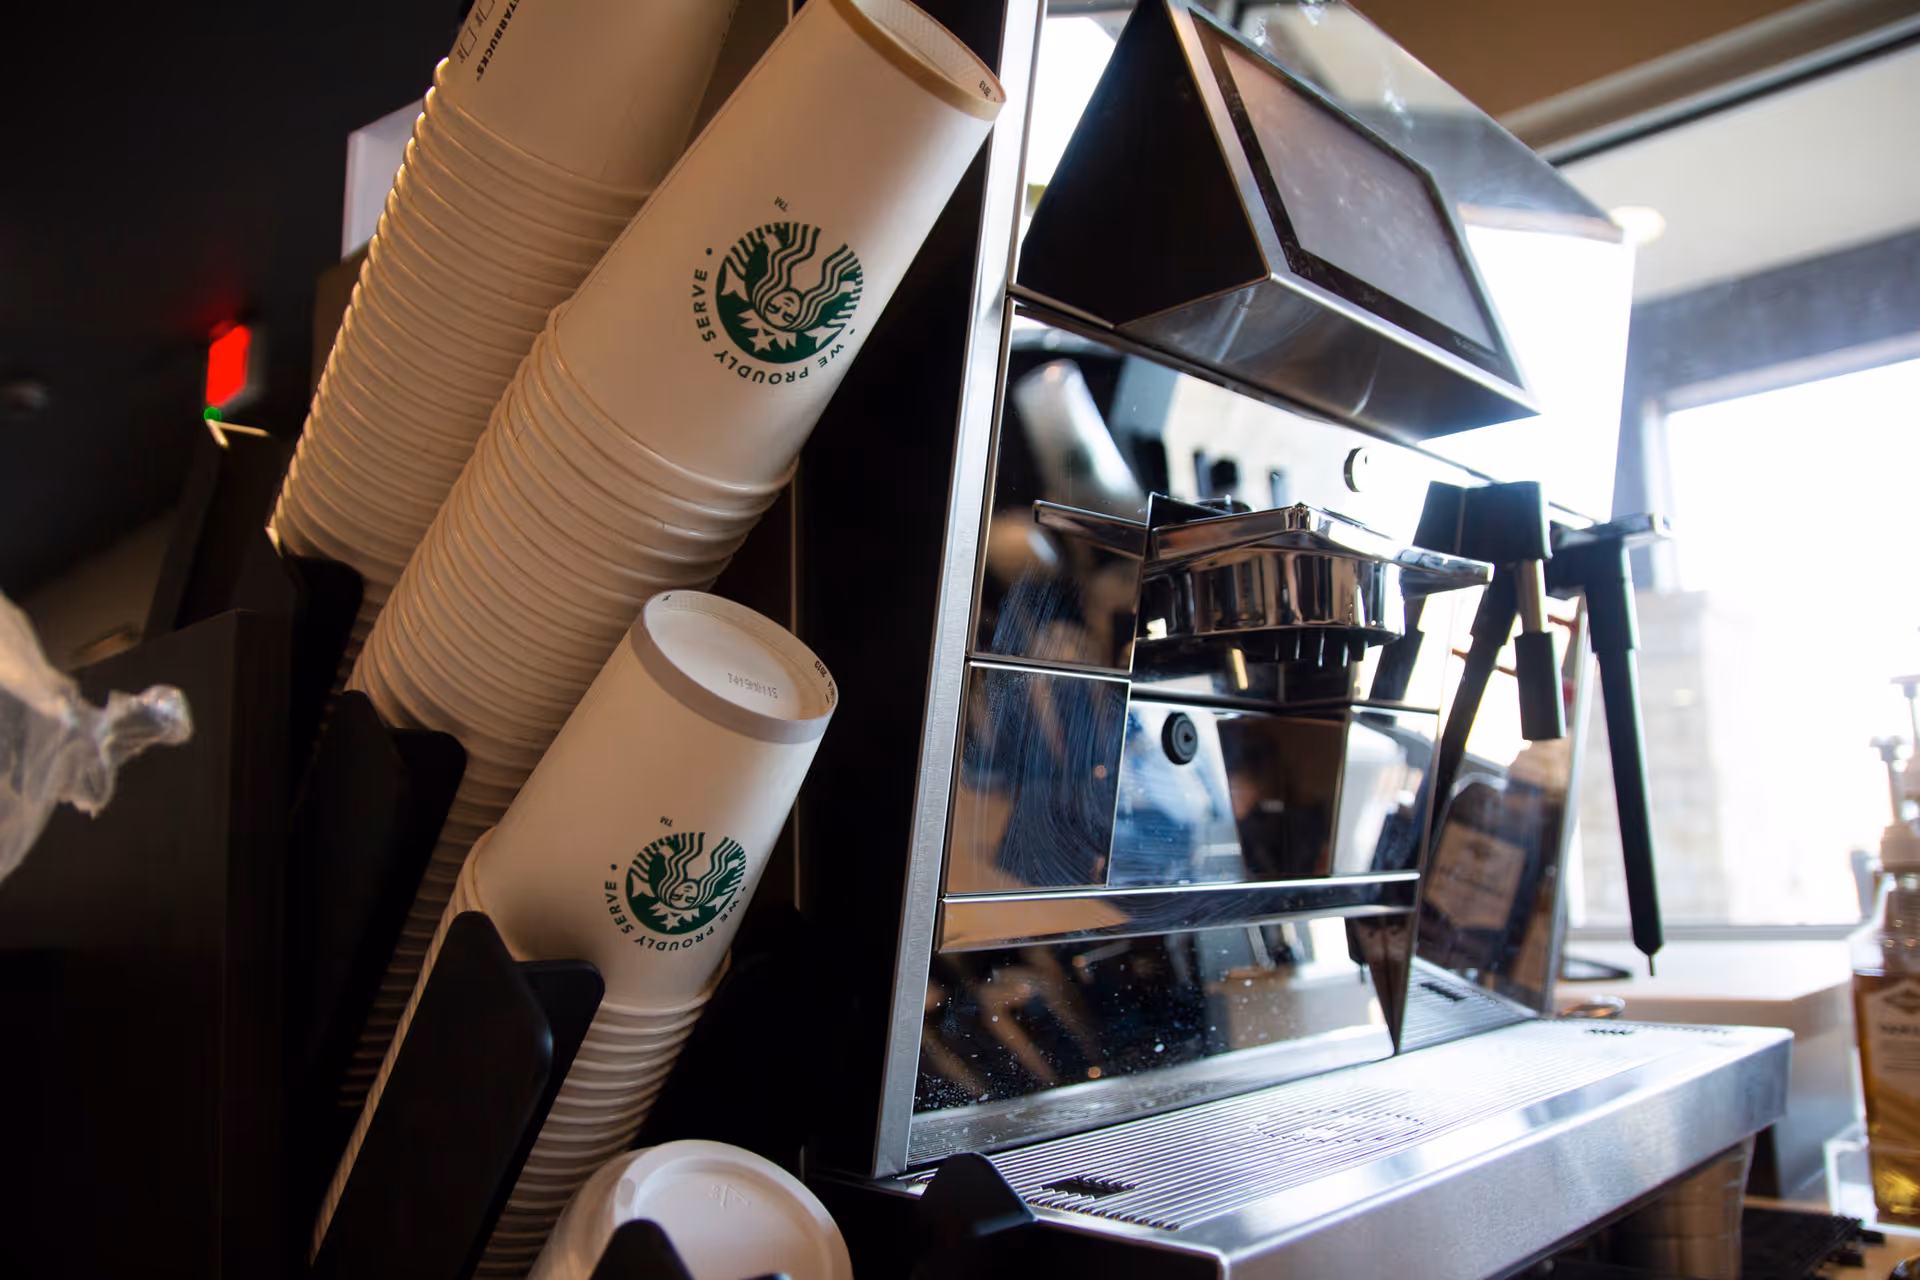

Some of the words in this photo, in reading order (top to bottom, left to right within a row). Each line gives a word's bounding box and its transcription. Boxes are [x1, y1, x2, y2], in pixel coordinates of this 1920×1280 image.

[692, 268, 717, 343] SERVE
[714, 350, 809, 385] PROUDLY
[817, 342, 845, 369] WE
[604, 880, 635, 935] SERVE
[719, 899, 740, 923] WE
[633, 926, 715, 952] PROUDLY
